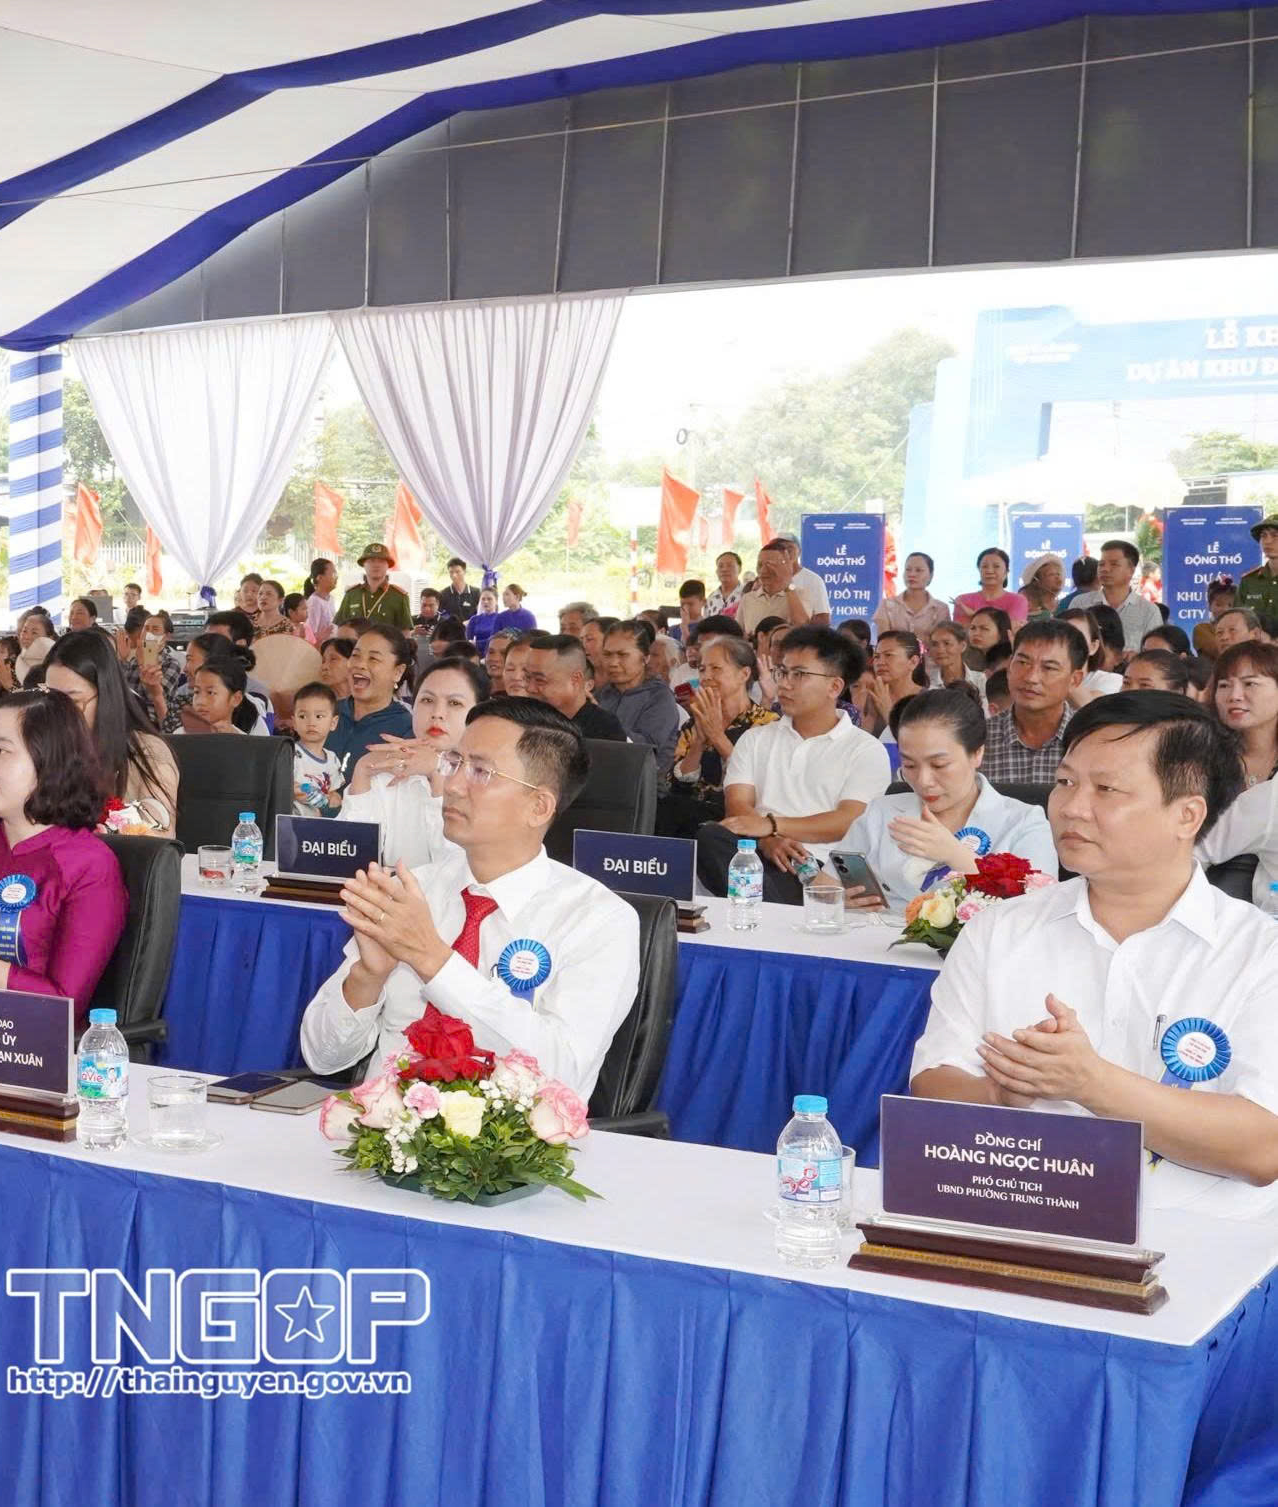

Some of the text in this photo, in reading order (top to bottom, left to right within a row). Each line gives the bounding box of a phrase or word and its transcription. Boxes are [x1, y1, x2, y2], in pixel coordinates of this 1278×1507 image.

[1207, 541, 1219, 553] LỄ
[817, 557, 844, 567] ĐỘNG
[1185, 554, 1217, 566] ĐỘNG
[825, 572, 856, 584] DỰ ÁN
[1177, 591, 1202, 601] KHU
[837, 606, 868, 615] HOME
[1178, 609, 1206, 619] CITY
[302, 840, 357, 857] ĐẠI BIỂU
[603, 857, 668, 876] ĐẠI BIỂU
[2, 1032, 17, 1046] ỦY
[14, 1053, 43, 1067] XUÂN
[975, 1131, 1042, 1151] ĐỒNG CHÍ
[924, 1144, 1094, 1177] HOÀNG NGỌC HUÂN
[972, 1175, 1042, 1192] PHÓ CHỦ TỊCH
[937, 1183, 1079, 1210] UBND PHƯỜNG TRUNG THÀNH
